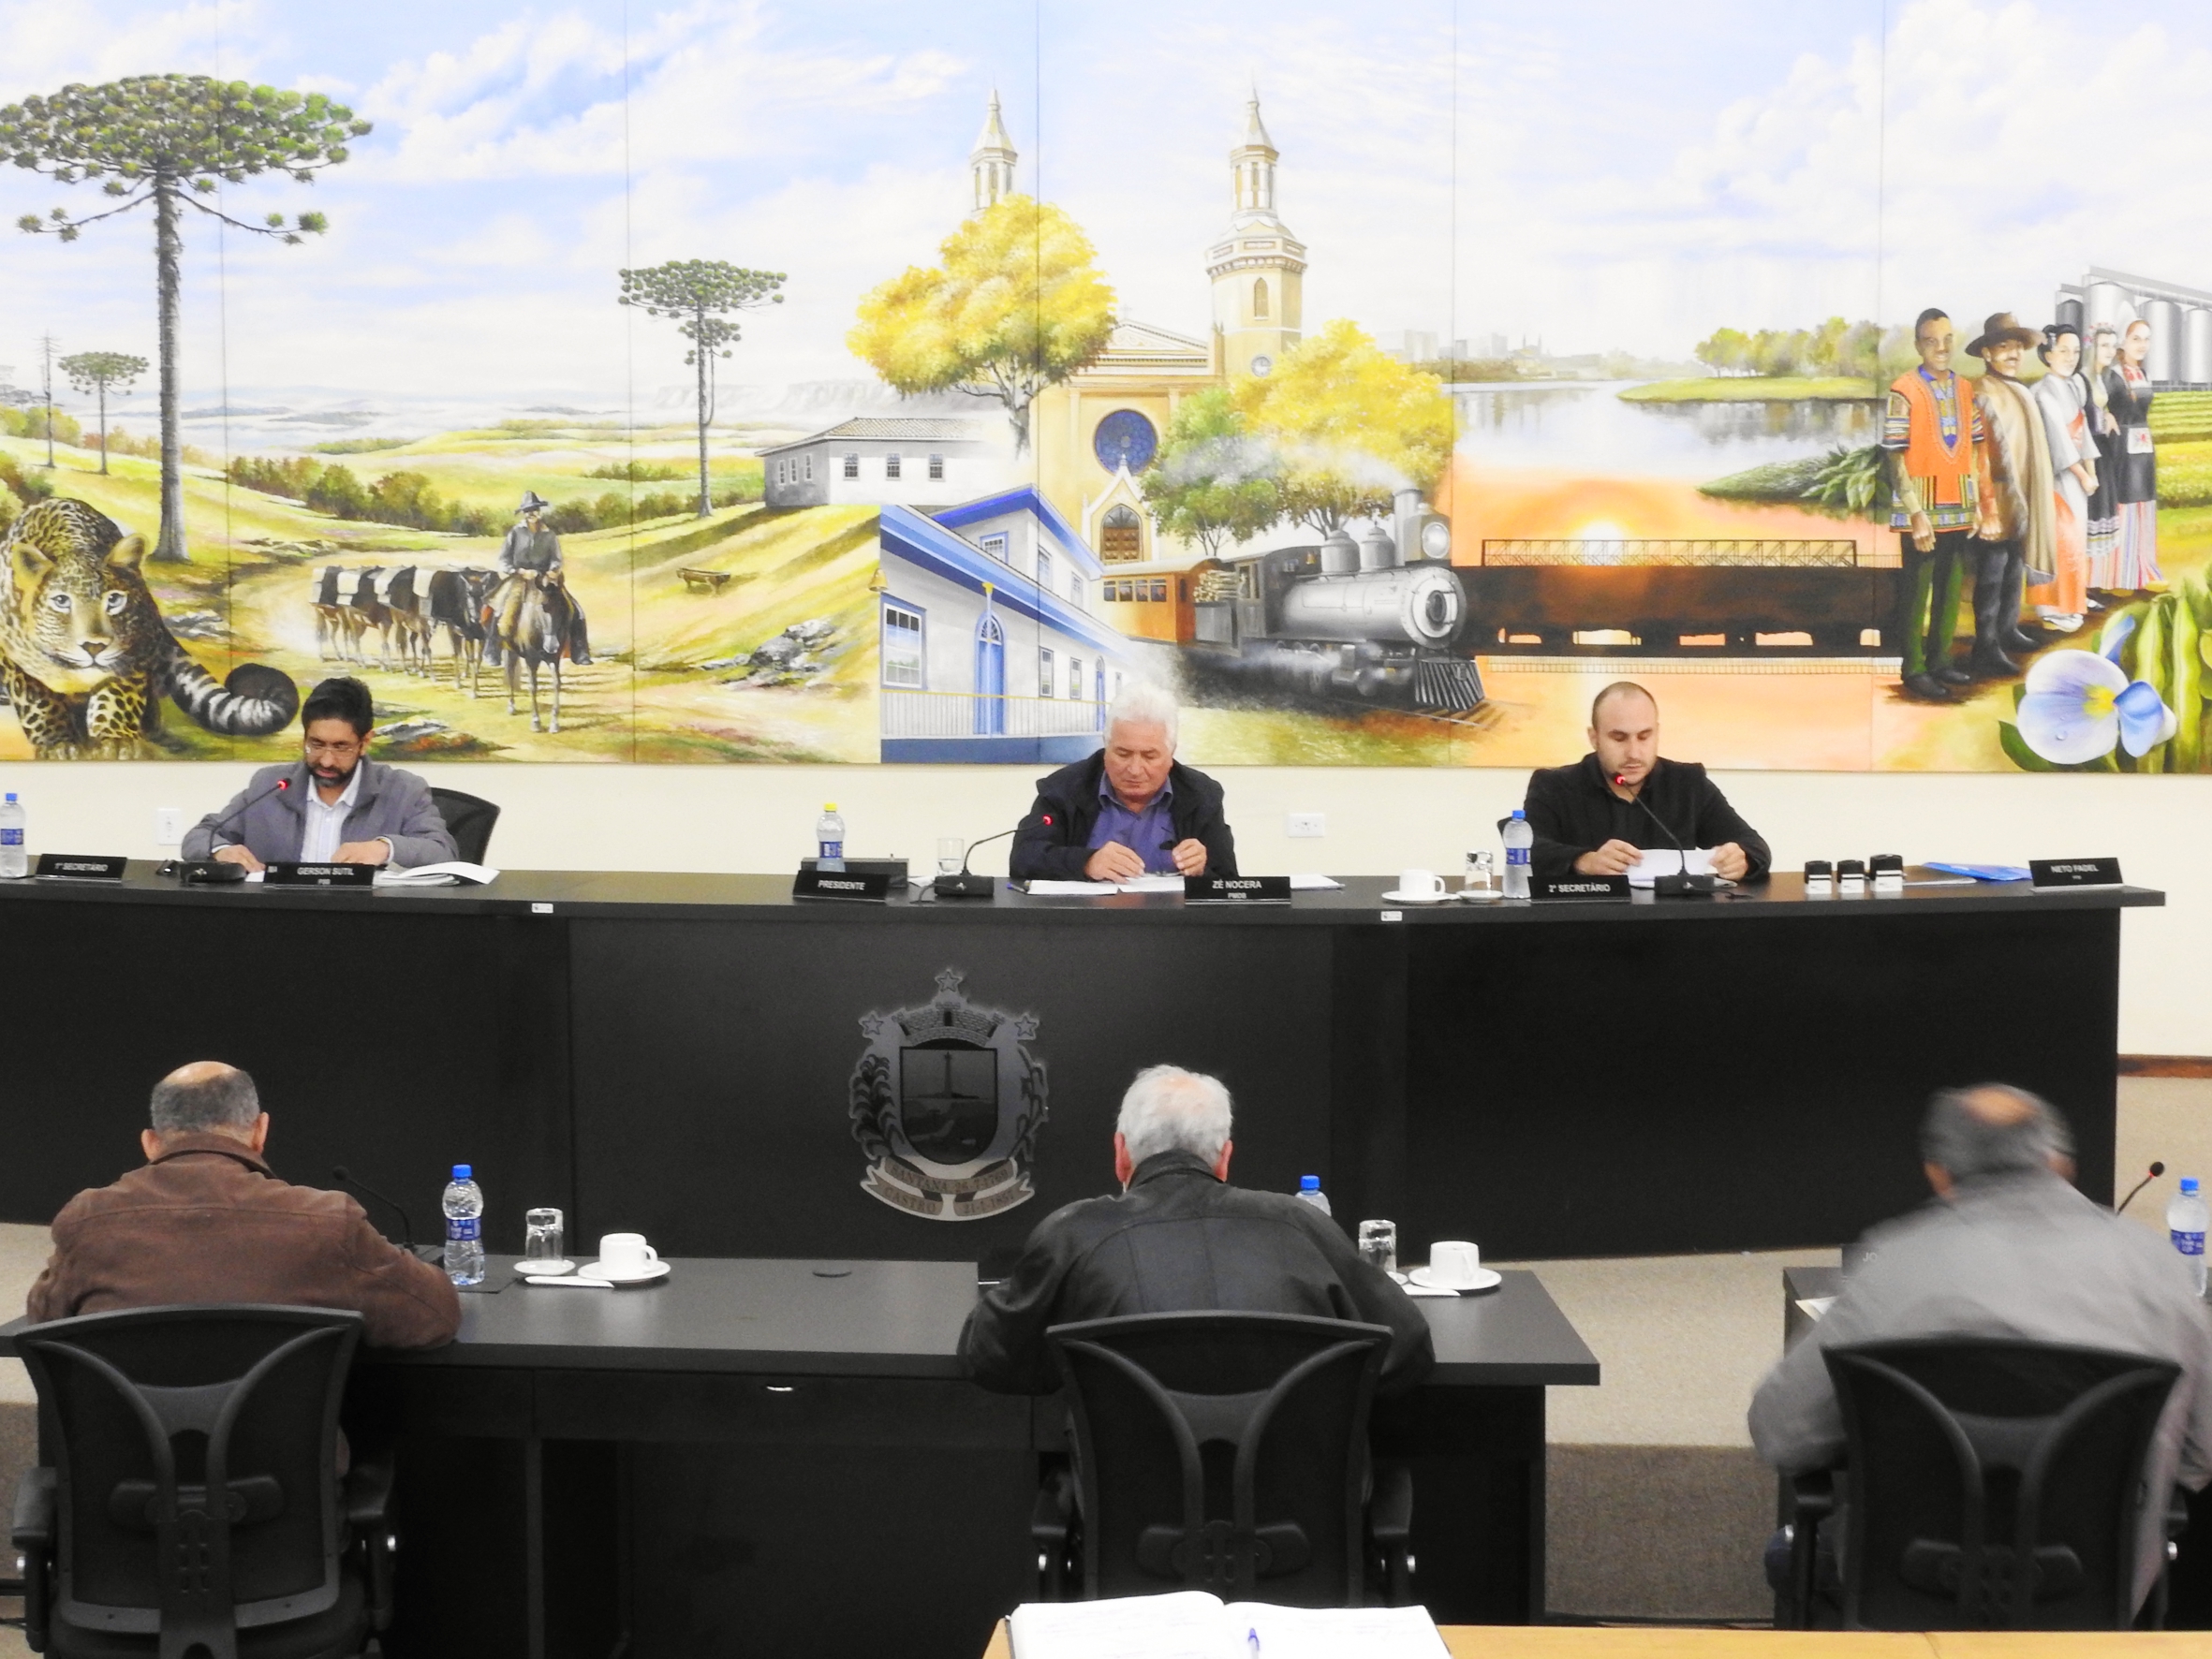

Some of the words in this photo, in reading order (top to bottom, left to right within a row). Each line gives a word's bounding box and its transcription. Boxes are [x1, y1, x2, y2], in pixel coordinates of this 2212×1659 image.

[297, 866, 332, 875] GERSON
[332, 866, 355, 875] SUTIL
[2050, 864, 2072, 873] NETO
[818, 879, 866, 891] PRESIDENTE
[1212, 878, 1223, 889] ZÉ
[1225, 880, 1262, 889] NOCERA
[1557, 882, 1611, 893] SECRETÁRIO
[884, 1186, 936, 1213] CASTRO
